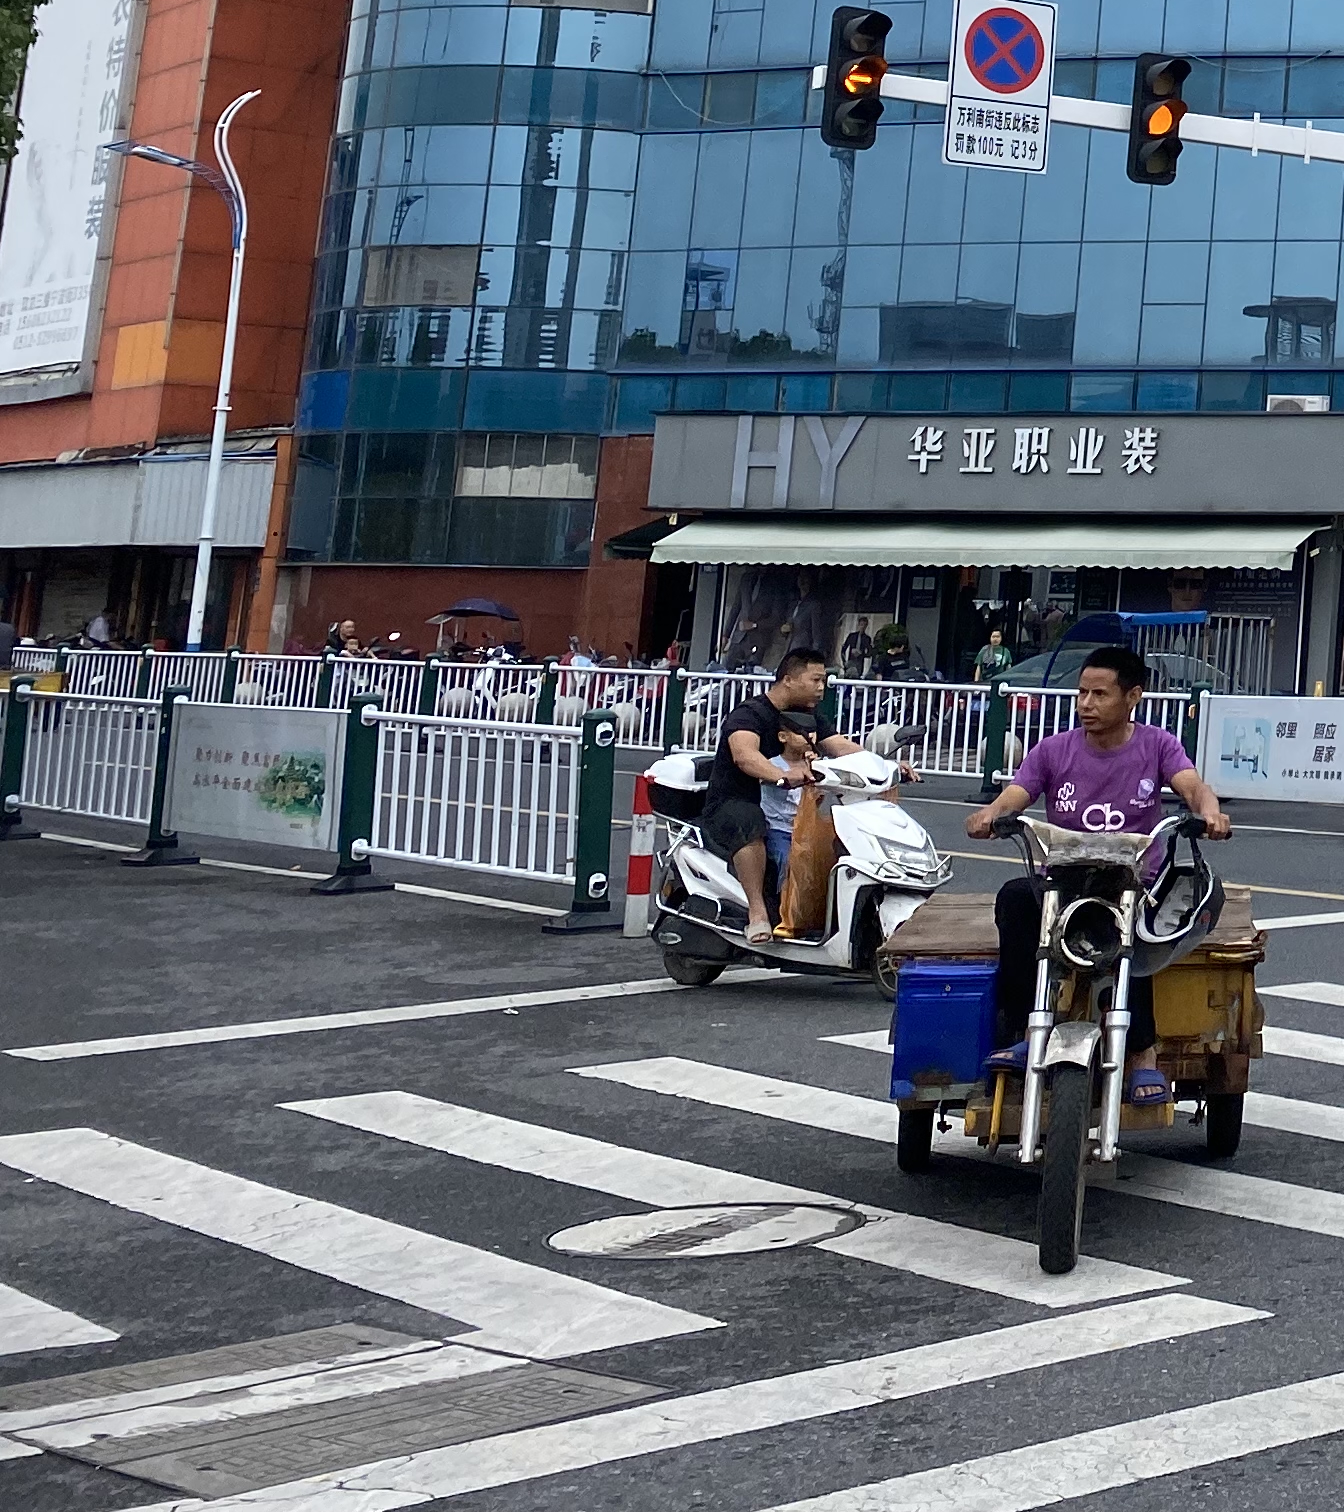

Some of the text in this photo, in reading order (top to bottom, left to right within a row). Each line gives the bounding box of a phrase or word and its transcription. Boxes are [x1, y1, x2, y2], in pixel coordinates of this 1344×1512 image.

[956, 106, 1040, 134] 万利南街违反此标志
[954, 133, 1039, 161] 罚款100元 记3分
[730, 415, 1165, 509] HY 华亚职业装
